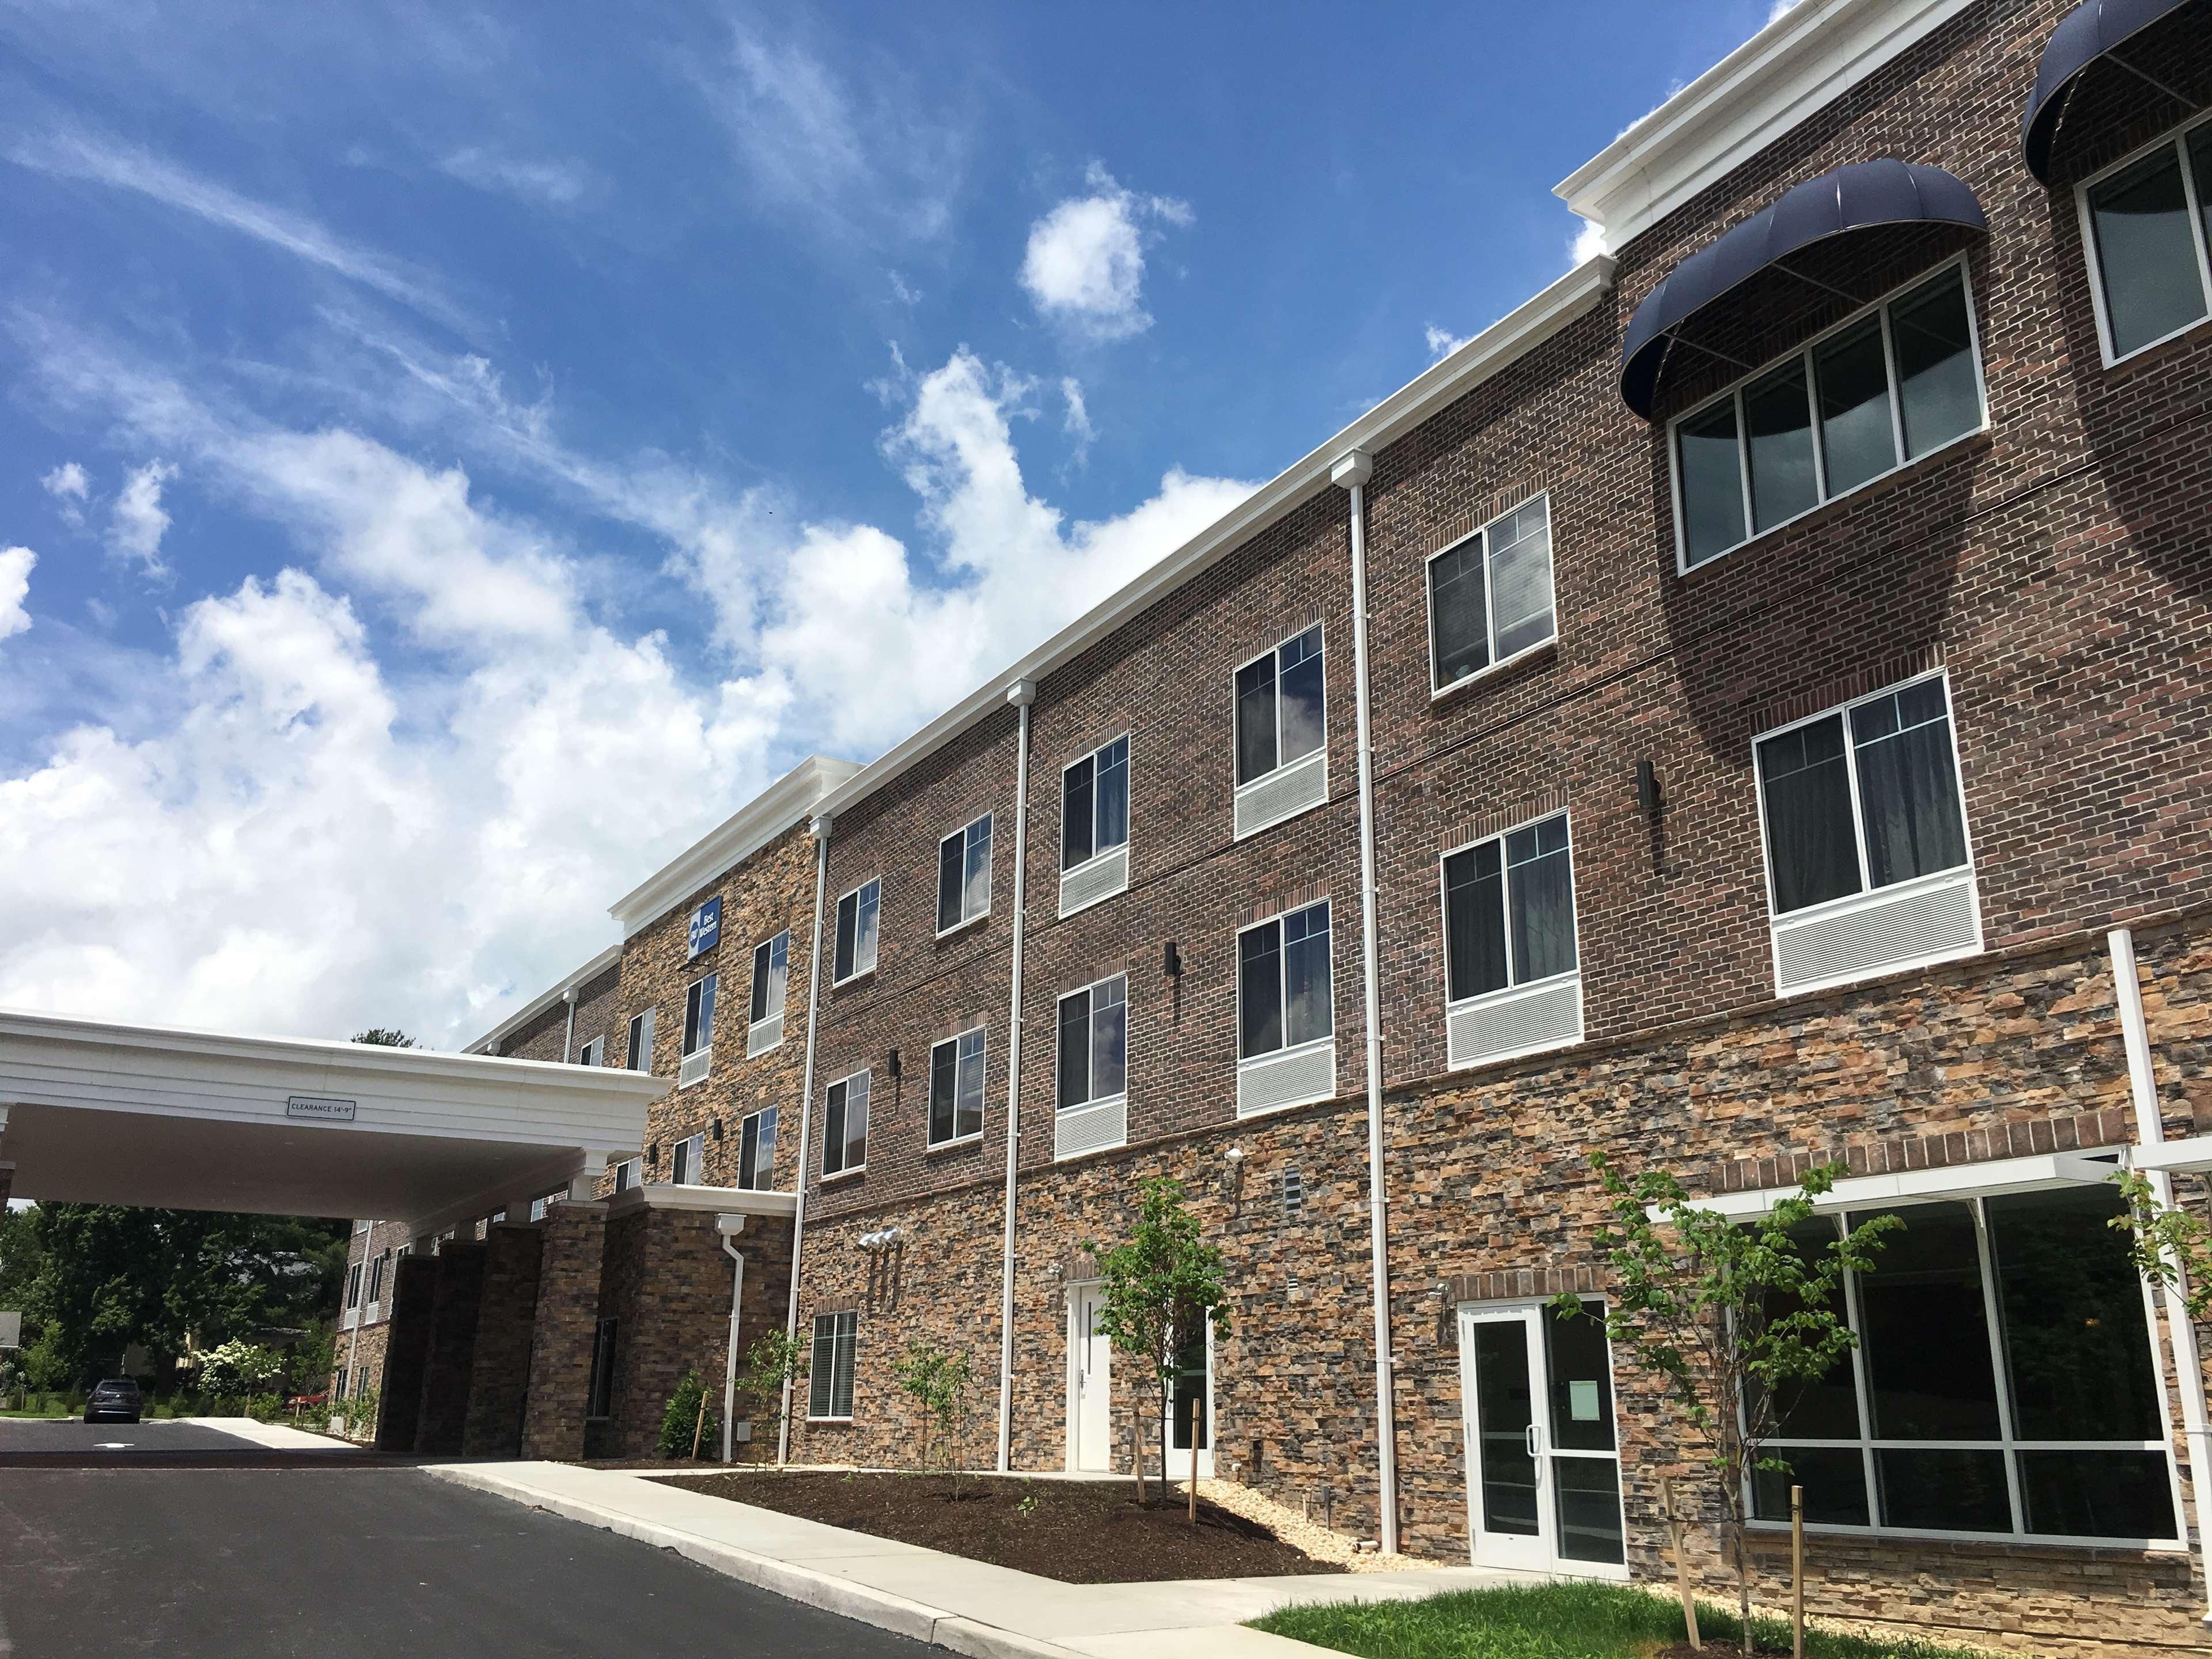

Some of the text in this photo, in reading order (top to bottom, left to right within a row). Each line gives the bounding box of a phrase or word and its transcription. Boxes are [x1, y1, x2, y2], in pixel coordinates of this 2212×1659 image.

[704, 912, 714, 926] Best
[699, 921, 717, 938] Western
[291, 1103, 332, 1112] CLEARANCE
